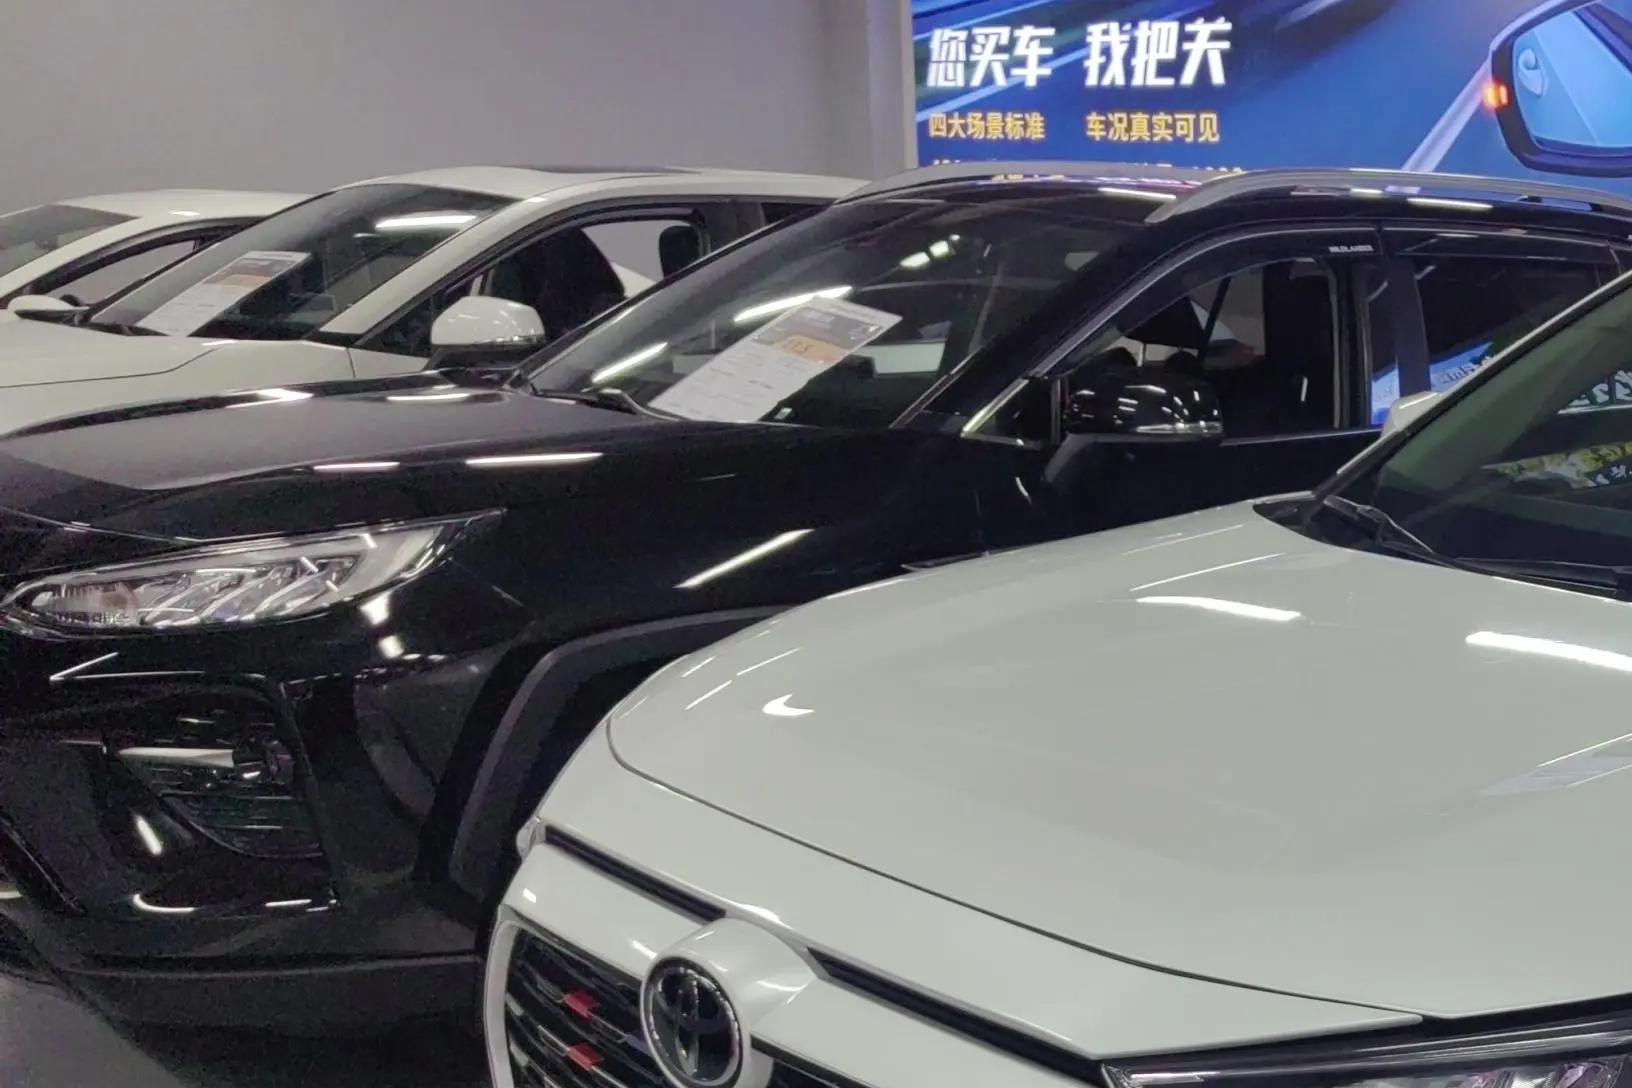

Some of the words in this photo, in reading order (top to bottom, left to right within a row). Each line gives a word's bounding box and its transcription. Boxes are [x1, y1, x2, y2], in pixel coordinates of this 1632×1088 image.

[928, 26, 1055, 86] 您买车
[1084, 17, 1232, 86] 我把关
[928, 112, 1046, 140] 四大场景标准
[1086, 111, 1221, 143] 车况真实可见
